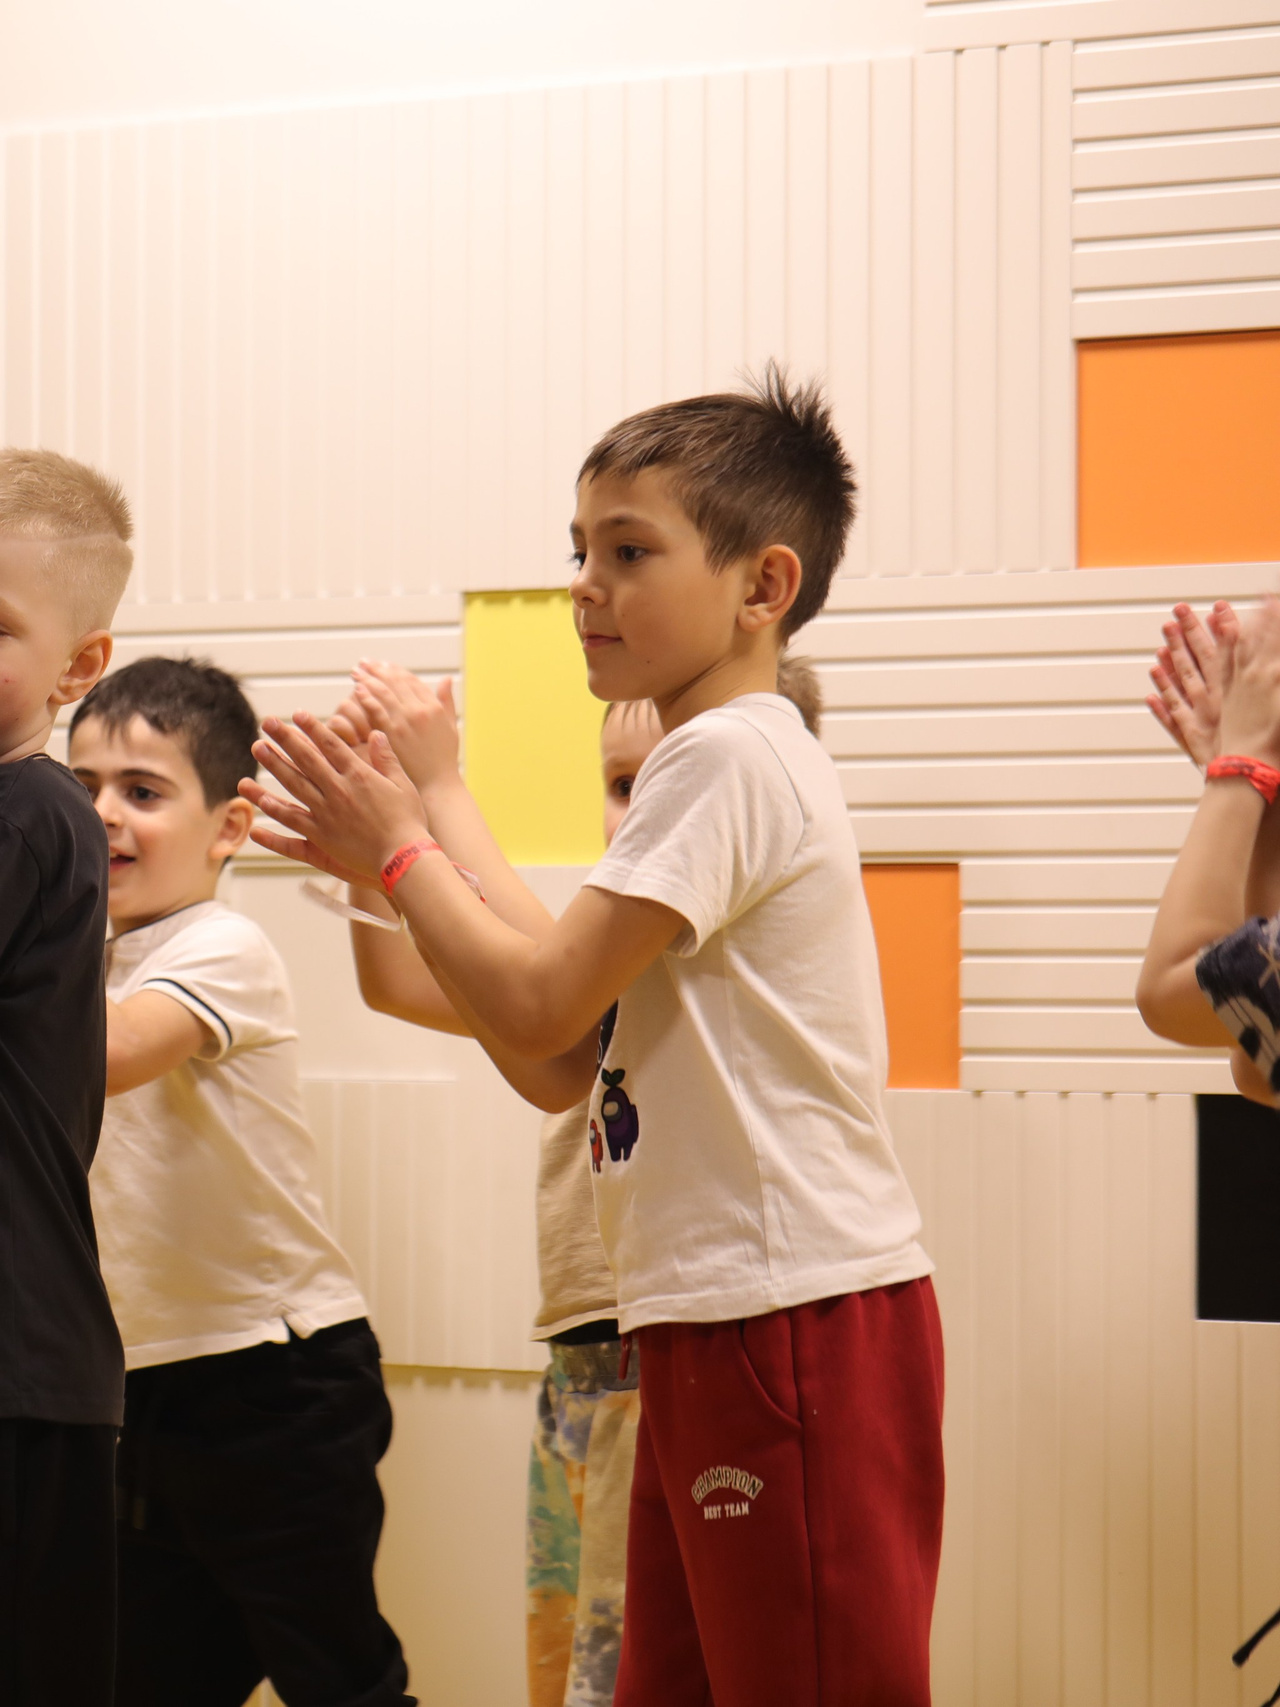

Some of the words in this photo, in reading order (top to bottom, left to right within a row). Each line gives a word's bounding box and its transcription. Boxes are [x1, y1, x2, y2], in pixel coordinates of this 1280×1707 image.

[691, 1466, 764, 1505] CHAMPION
[704, 1505, 721, 1520] BEST
[725, 1501, 749, 1518] TEAM
